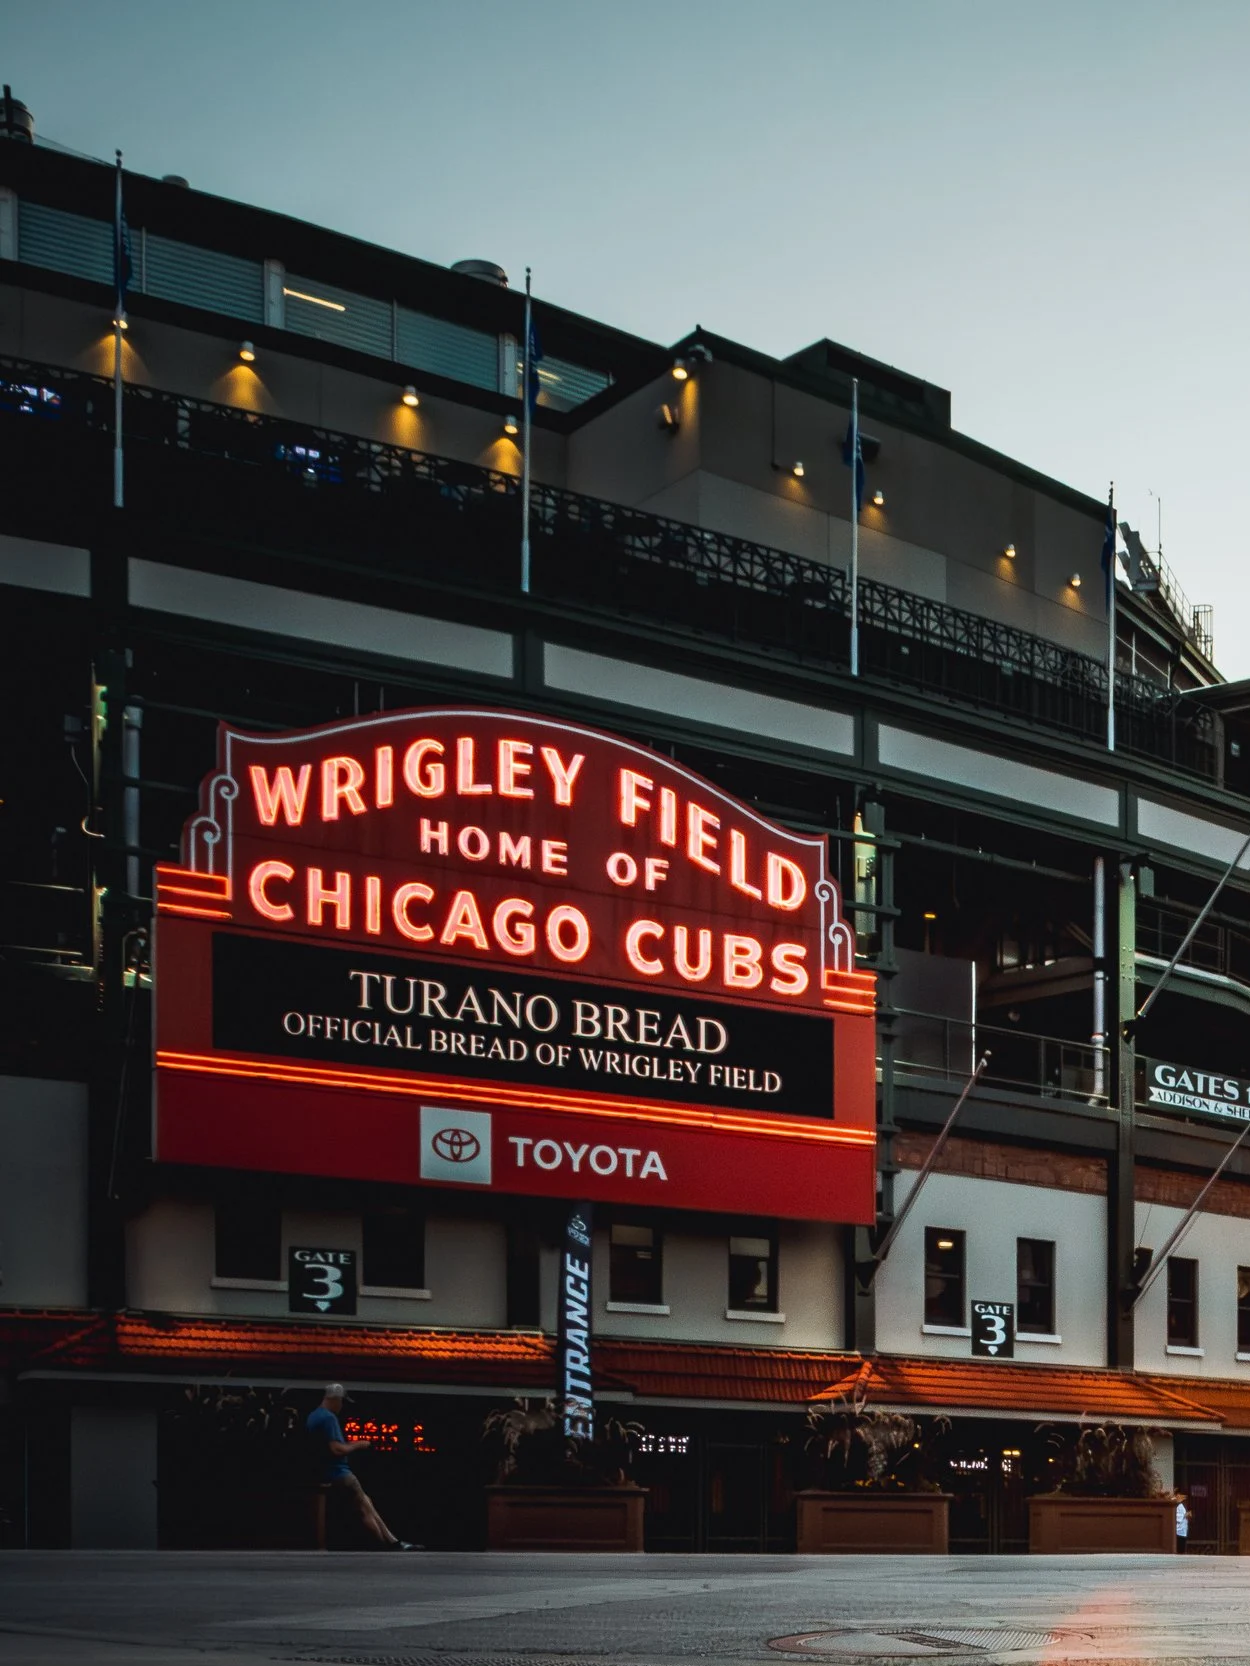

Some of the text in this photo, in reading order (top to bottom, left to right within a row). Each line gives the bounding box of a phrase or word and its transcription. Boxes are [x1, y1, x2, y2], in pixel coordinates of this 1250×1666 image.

[249, 737, 807, 912] WRIGLEY FIELD
[420, 817, 669, 891] HOME OF
[249, 860, 809, 995] CHICAGO CUBS
[349, 970, 729, 1055] TURANO BREAD
[283, 1011, 782, 1093] OFFICIAL BREAD OF WRIGLEY FIELD
[1154, 1064, 1240, 1101] GATES
[1155, 1090, 1210, 1110] ADDISON
[508, 1136, 668, 1181] TOYOTA
[294, 1250, 352, 1264] GATE
[302, 1263, 344, 1299] 3
[974, 1303, 1011, 1316] GATE
[979, 1314, 1006, 1345] 3
[564, 1253, 594, 1440] ENTRANCE
